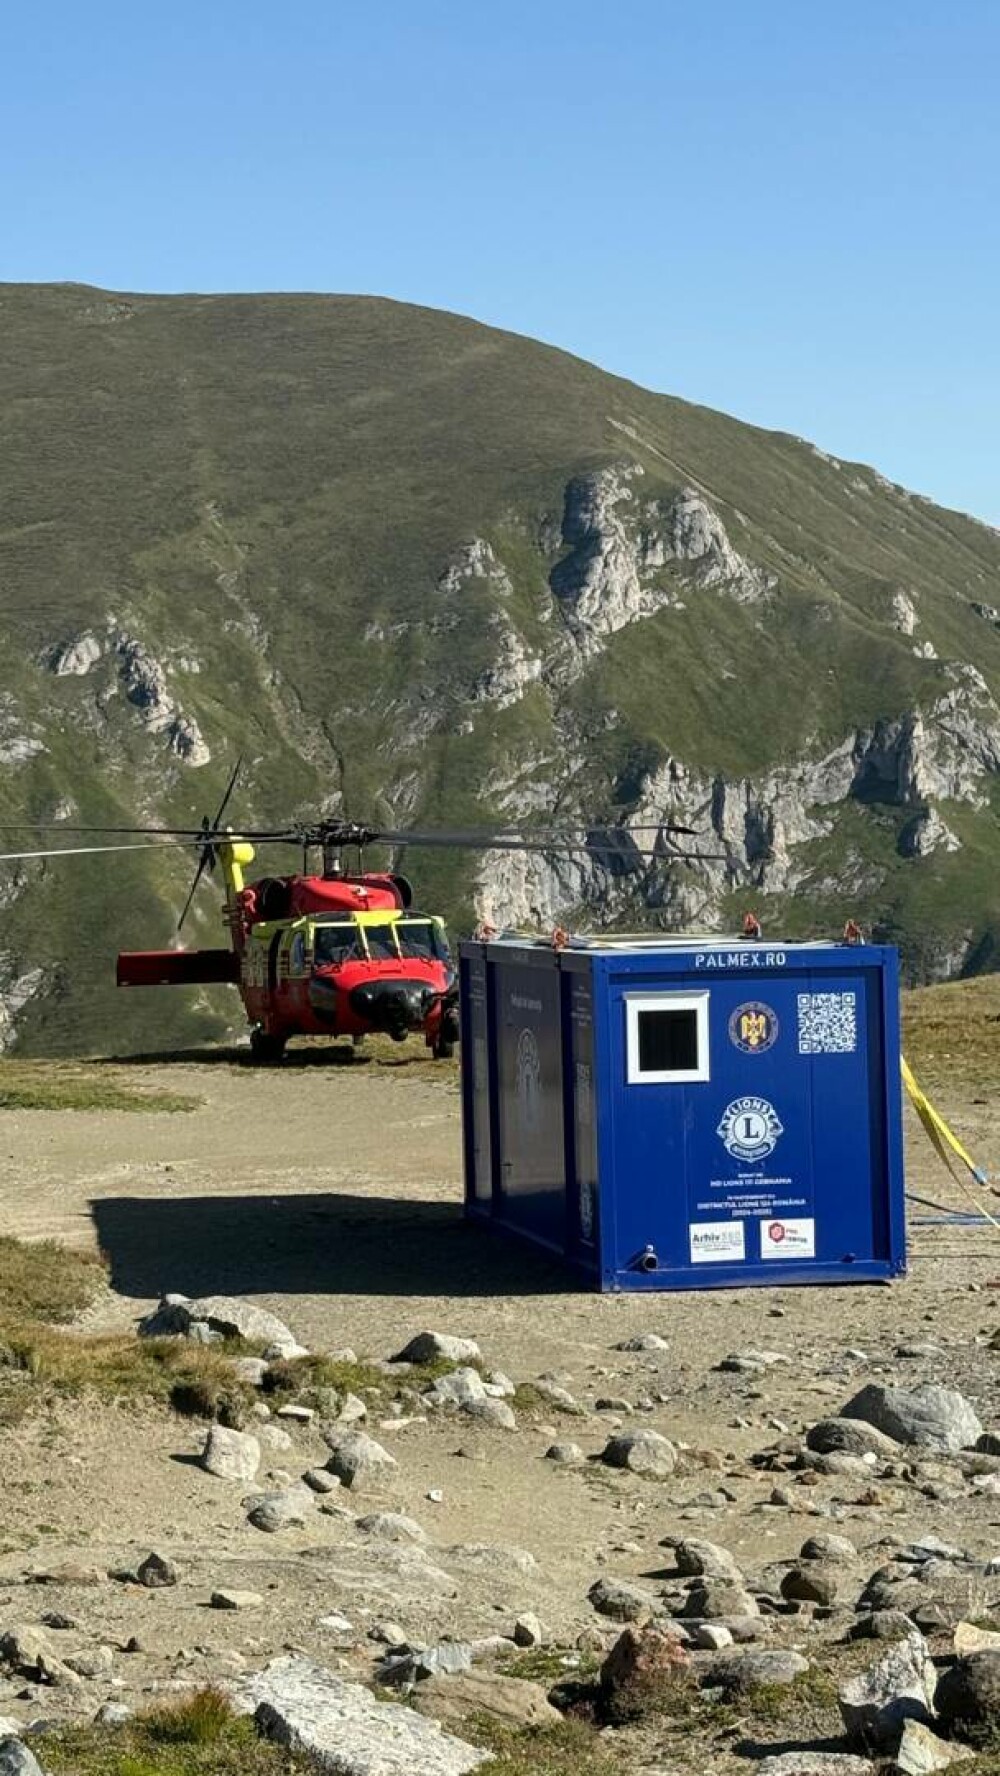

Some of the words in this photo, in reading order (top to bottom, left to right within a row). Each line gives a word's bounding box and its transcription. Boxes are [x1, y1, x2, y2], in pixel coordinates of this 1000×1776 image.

[695, 952, 786, 968] PALMEX.RO
[731, 1099, 769, 1115] LIONS
[743, 1117, 760, 1139] L
[723, 1179, 744, 1187] LIONS
